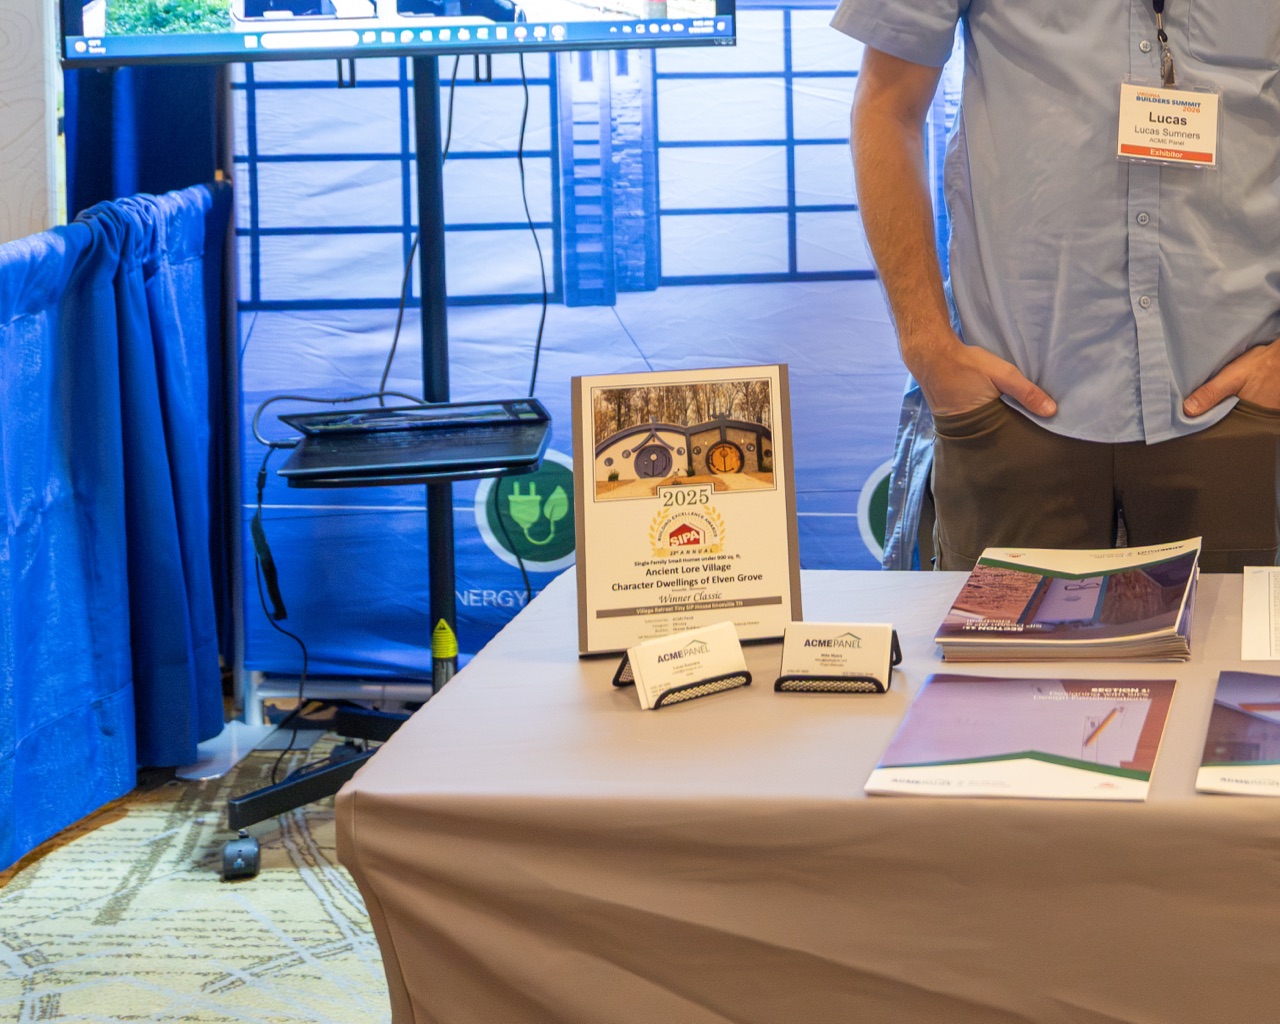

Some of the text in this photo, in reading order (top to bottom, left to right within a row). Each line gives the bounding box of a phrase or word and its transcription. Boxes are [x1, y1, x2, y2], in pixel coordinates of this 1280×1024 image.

[1136, 96, 1201, 108] BUILDERS SUMMIT
[1149, 111, 1187, 126] Lucas
[1134, 125, 1160, 135] Lucas
[1149, 137, 1167, 145] ACME
[1150, 148, 1184, 158] Exhibitor
[663, 489, 709, 507] 2025
[670, 530, 700, 547] SIPA
[645, 563, 731, 576] Ancient Lore Village
[611, 573, 763, 592] Character Dwellings of Elven Grove
[455, 590, 527, 607] NERGY
[659, 591, 722, 604] Winner Classic
[804, 639, 862, 649] ACMEPANEL
[657, 645, 711, 664] ACMEPANEL
